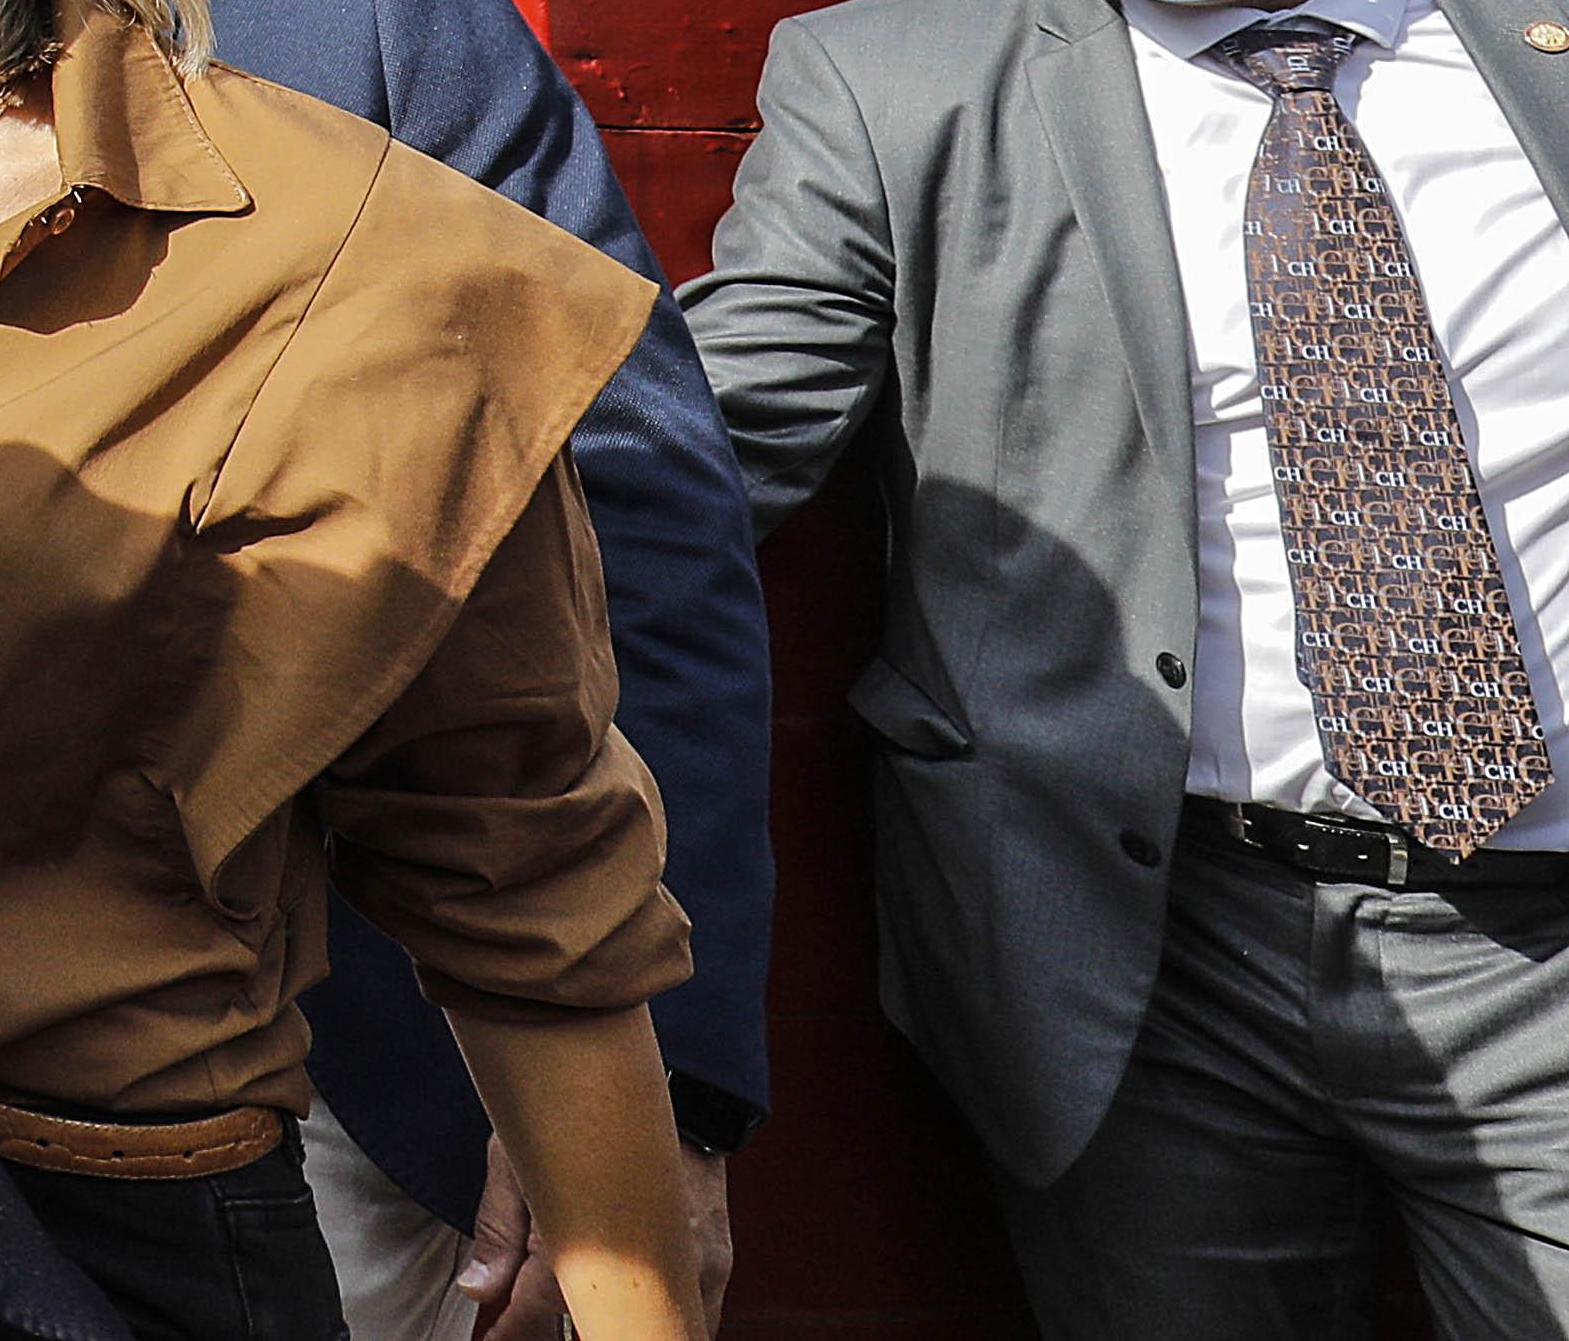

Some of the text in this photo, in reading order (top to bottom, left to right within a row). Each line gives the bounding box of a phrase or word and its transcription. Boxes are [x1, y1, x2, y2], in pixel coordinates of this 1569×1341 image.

[1314, 135, 1340, 151] CH
[1277, 178, 1301, 194] CH
[1329, 220, 1356, 235] CH
[1288, 261, 1316, 277] CH
[1385, 262, 1414, 277] CH
[1344, 303, 1373, 319] CH
[1302, 345, 1330, 360] CH
[1403, 346, 1431, 362] CH
[1260, 385, 1289, 400] CH
[1360, 387, 1389, 403] CH
[1317, 428, 1345, 443] CH
[1420, 430, 1450, 446] CH
[1274, 466, 1303, 482] CH
[1376, 471, 1405, 487] CH
[1331, 510, 1360, 526] CH
[1438, 515, 1468, 531] CH
[1287, 549, 1317, 565] CH
[1392, 554, 1422, 570] CH
[1346, 593, 1377, 609] CH
[1453, 598, 1483, 614] CH
[1302, 632, 1332, 648] CH
[1408, 638, 1440, 654] CH
[1362, 677, 1393, 693] CH
[1470, 681, 1500, 698] CH
[1319, 716, 1349, 733] CH
[1422, 721, 1453, 737] CH
[1378, 761, 1409, 777] CH
[1485, 765, 1517, 781] CH
[1439, 804, 1469, 820] CH
